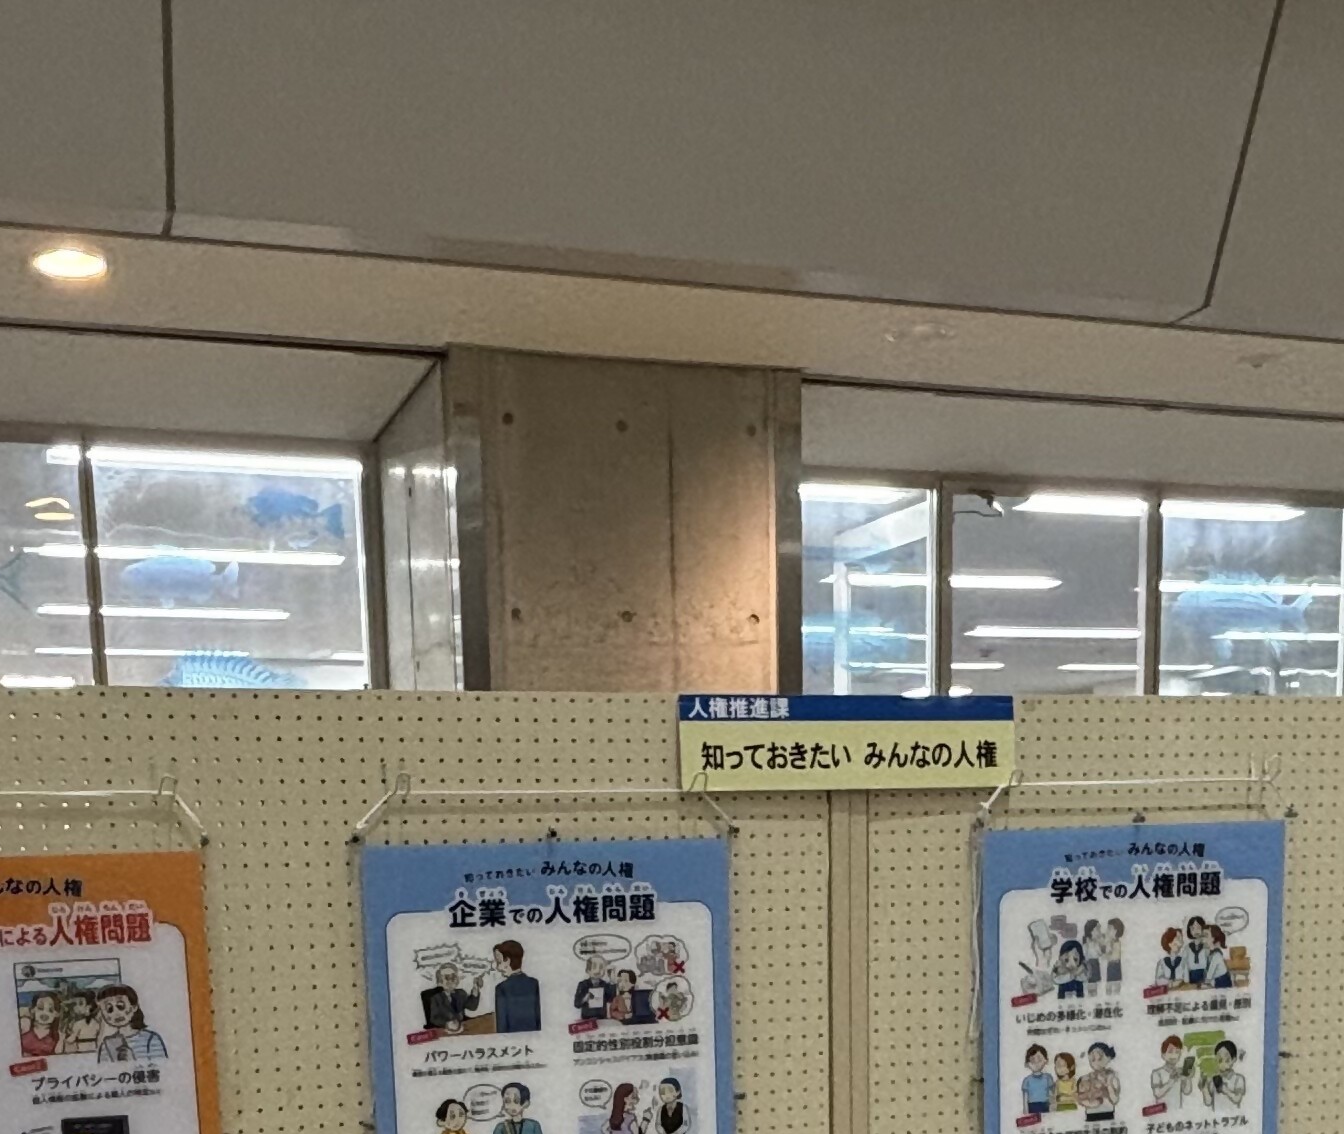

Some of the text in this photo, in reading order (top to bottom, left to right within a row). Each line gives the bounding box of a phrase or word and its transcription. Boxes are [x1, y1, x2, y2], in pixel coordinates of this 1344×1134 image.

[688, 697, 789, 719] 人権推進課
[701, 740, 998, 771] 知っておきたい みんなの人権
[541, 860, 634, 879] みんなの人権
[1050, 871, 1222, 903] 学校での人権問題
[449, 892, 656, 928] 企業での人権問題
[424, 1045, 534, 1062] パワーハラスメント
[32, 1070, 160, 1091] プライバシーの侵害
[1146, 1115, 1249, 1134] 子どものネットトラブル
